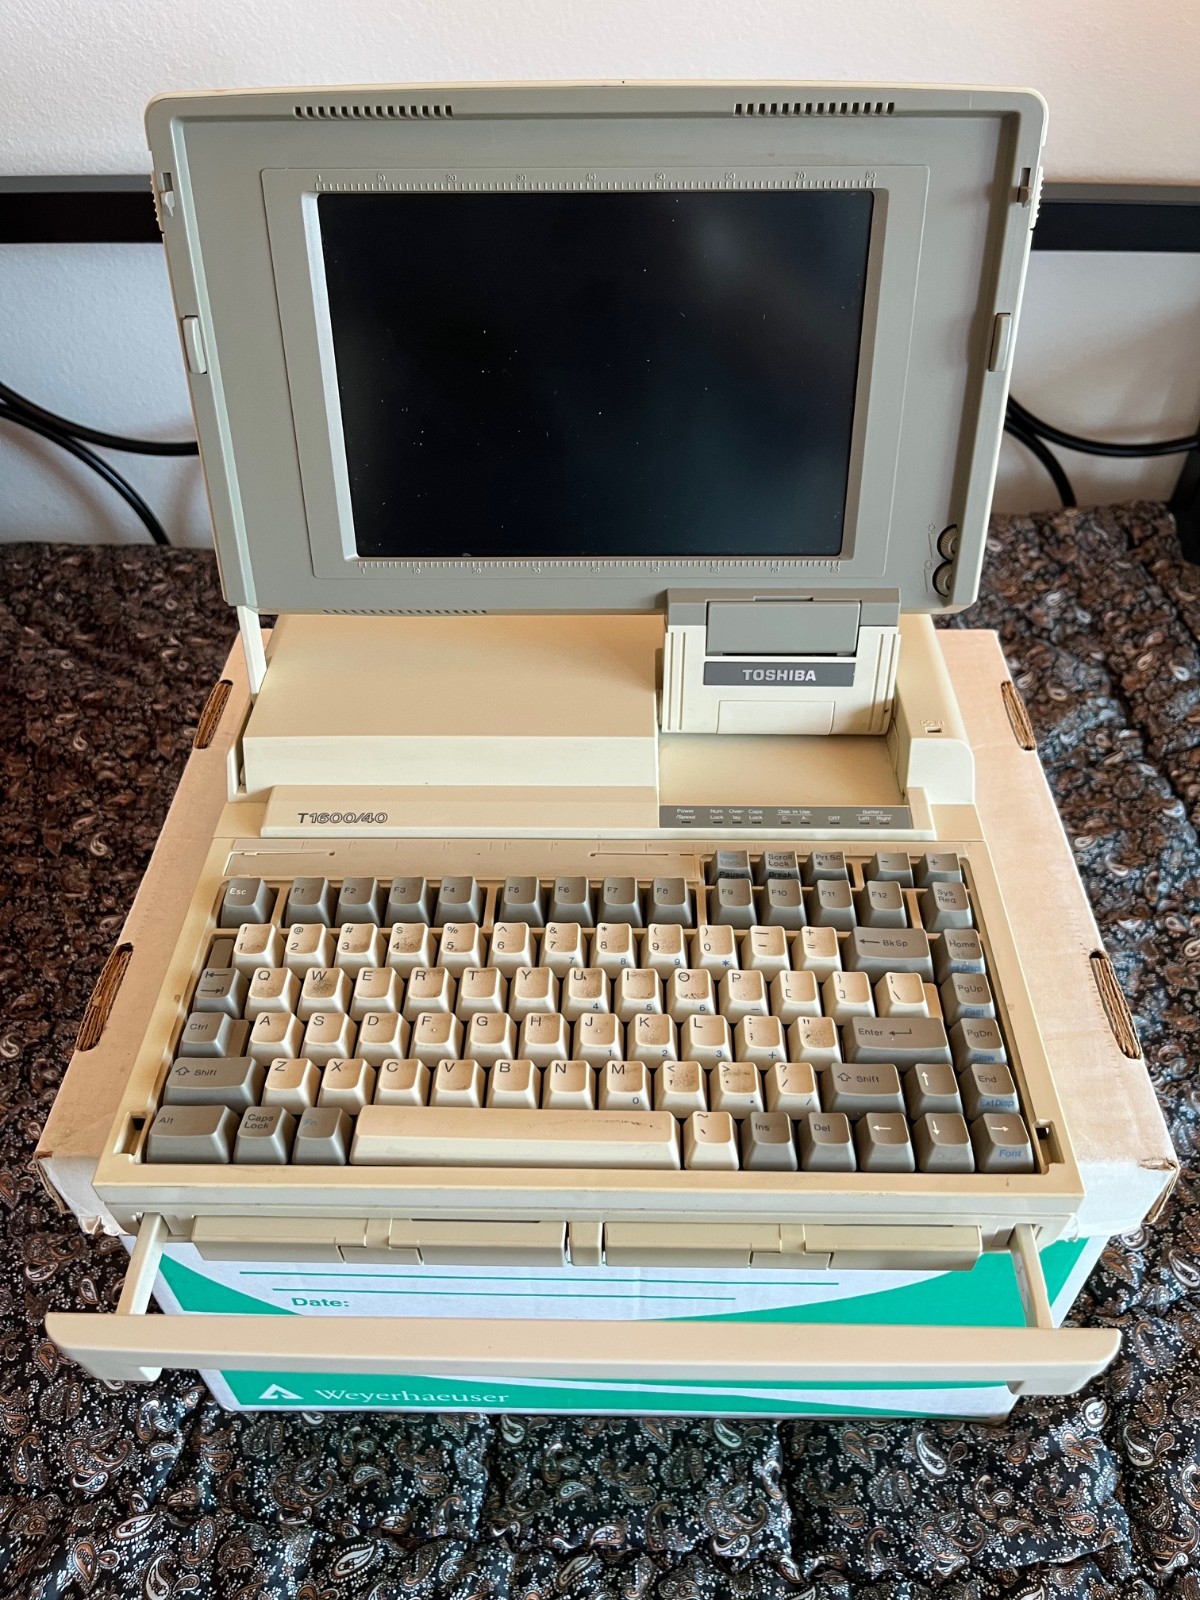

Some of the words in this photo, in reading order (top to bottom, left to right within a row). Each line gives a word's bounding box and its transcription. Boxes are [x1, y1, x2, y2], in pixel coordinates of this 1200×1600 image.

[446, 174, 457, 182] 20
[515, 173, 527, 182] 30
[655, 173, 666, 181] 50
[725, 172, 736, 181] 60
[795, 171, 806, 180] 70
[742, 669, 816, 681] TOSHIBA
[297, 812, 388, 824] T1600/40
[768, 853, 793, 861] Scroll
[230, 887, 247, 895] Esc
[937, 889, 954, 897] Sys
[939, 896, 956, 904] Req
[293, 926, 304, 935] @
[345, 926, 353, 934] #
[447, 926, 458, 934] %
[549, 926, 557, 934] &
[239, 942, 244, 951] 1
[290, 942, 299, 951] 2
[342, 942, 350, 950] 3
[392, 941, 400, 950] 4
[446, 941, 454, 950] 5
[497, 941, 505, 950] 6
[549, 941, 557, 949] 7
[600, 941, 608, 950] 8
[652, 942, 660, 951] 9
[703, 943, 711, 952] 0
[949, 940, 976, 948] Home
[568, 956, 575, 964] 7
[620, 957, 627, 965] 8
[674, 958, 681, 966] 9
[257, 970, 270, 981] Q
[311, 970, 327, 981] W
[362, 970, 374, 981] E
[414, 970, 426, 981] R
[468, 970, 479, 981] T
[521, 970, 532, 980] Y
[573, 970, 583, 981] U
[677, 971, 690, 982] O
[731, 973, 741, 982] P
[785, 988, 792, 997] [
[957, 984, 983, 993] PgUp
[839, 989, 846, 999] ]
[645, 1003, 653, 1011] 5
[699, 1004, 706, 1012] 6
[964, 1007, 984, 1016] Fast
[259, 1016, 271, 1026] A
[313, 1016, 325, 1026] S
[367, 1016, 379, 1026] D
[421, 1016, 432, 1026] F
[476, 1016, 488, 1026] G
[530, 1016, 541, 1026] H
[584, 1017, 593, 1026] J
[639, 1017, 650, 1026] K
[693, 1018, 703, 1028] L
[189, 1022, 208, 1031] Ctrl
[858, 1028, 884, 1036] Enter
[967, 1029, 993, 1038] PgDn
[607, 1049, 613, 1057] 1
[661, 1049, 668, 1057] 2
[716, 1049, 723, 1057] 3
[972, 1053, 995, 1062] Slow
[274, 1061, 287, 1071] Z
[331, 1061, 344, 1071] X
[386, 1062, 399, 1072] C
[444, 1062, 456, 1072] V
[499, 1062, 511, 1072] B
[555, 1063, 567, 1073] N
[611, 1063, 625, 1074] M
[779, 1065, 787, 1073] ?
[194, 1069, 218, 1077] Shift
[856, 1075, 880, 1083] Shift
[978, 1075, 997, 1083] End
[247, 1114, 274, 1122] Caps
[244, 1121, 269, 1129] Lock
[755, 1124, 770, 1132] Ins
[814, 1124, 830, 1132] Del
[999, 1149, 1022, 1158] Font
[291, 1297, 350, 1307] Date:
[313, 1389, 511, 1403] Weyerhaeuser
